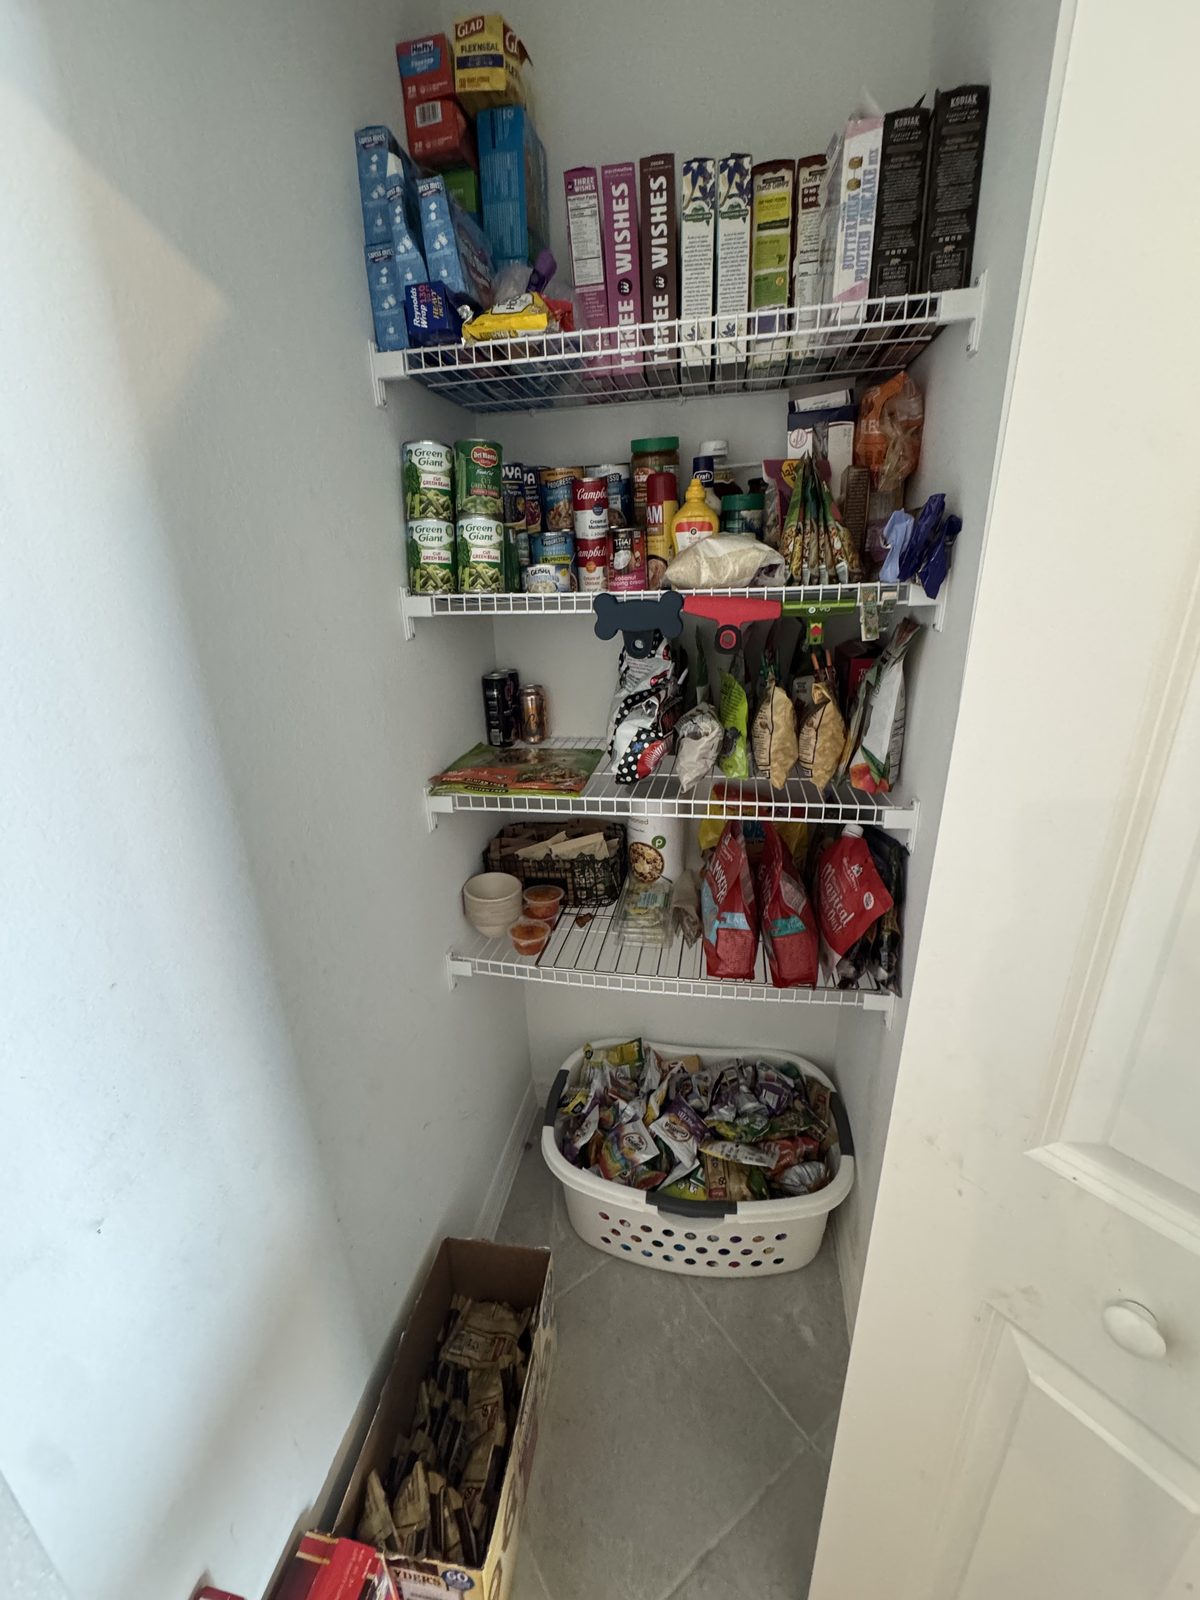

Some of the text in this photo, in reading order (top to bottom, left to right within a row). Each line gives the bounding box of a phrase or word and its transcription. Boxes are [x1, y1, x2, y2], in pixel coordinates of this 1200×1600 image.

[457, 19, 483, 37] GLAD
[950, 93, 978, 108] KODIAK
[894, 116, 920, 129] KODIAK
[611, 182, 632, 275] WISHES
[650, 175, 668, 270] WISHES
[410, 286, 421, 327] Reynolds
[420, 304, 428, 328] Wrap
[415, 448, 442, 457] Green
[418, 457, 443, 467] Giant
[647, 505, 663, 524] AM
[415, 525, 442, 533] Green
[465, 523, 493, 532] Green
[419, 533, 443, 542] Giant
[469, 531, 493, 541] Giant
[821, 862, 855, 928] Magical
